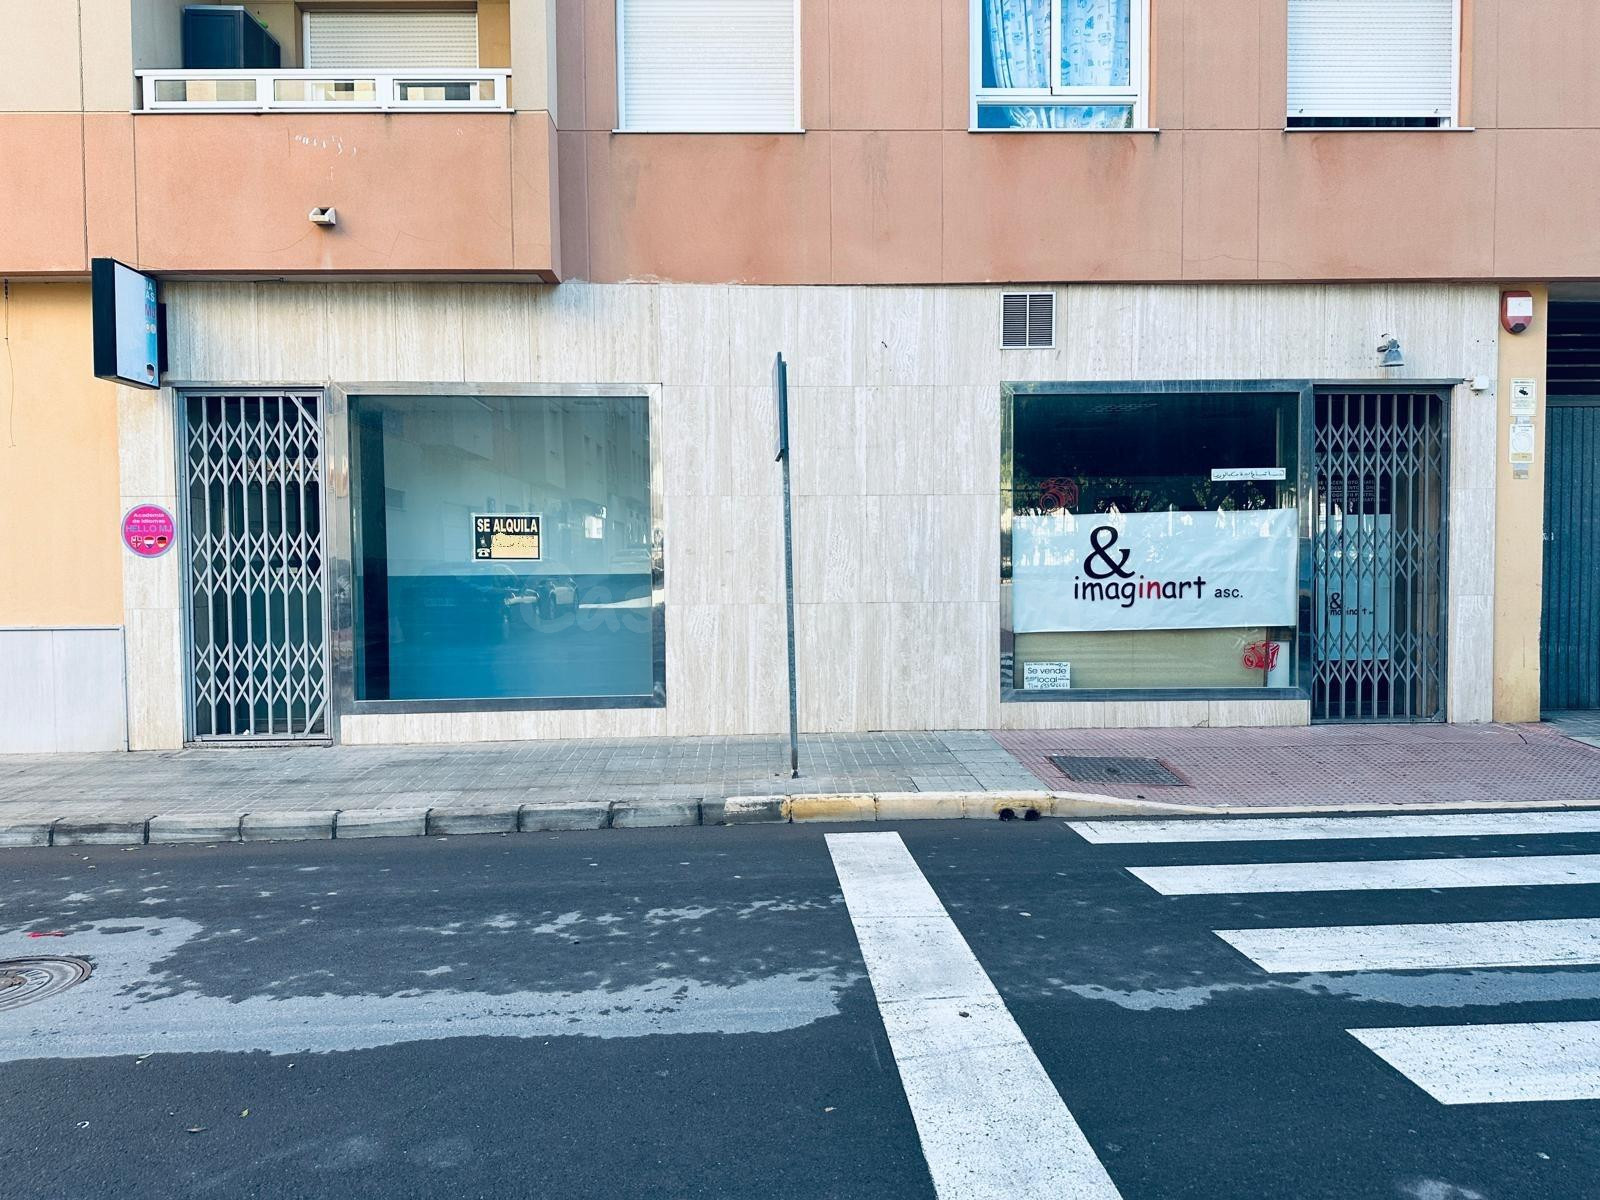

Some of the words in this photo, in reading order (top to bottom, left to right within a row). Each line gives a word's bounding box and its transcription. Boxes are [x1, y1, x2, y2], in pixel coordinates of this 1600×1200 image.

[477, 518, 491, 533] SE
[493, 518, 538, 534] ALQUILA
[1083, 525, 1135, 579] &
[1074, 575, 1206, 608] imaginart
[1214, 588, 1243, 598] asc.
[1027, 667, 1038, 675] Se
[1040, 667, 1067, 675] vende
